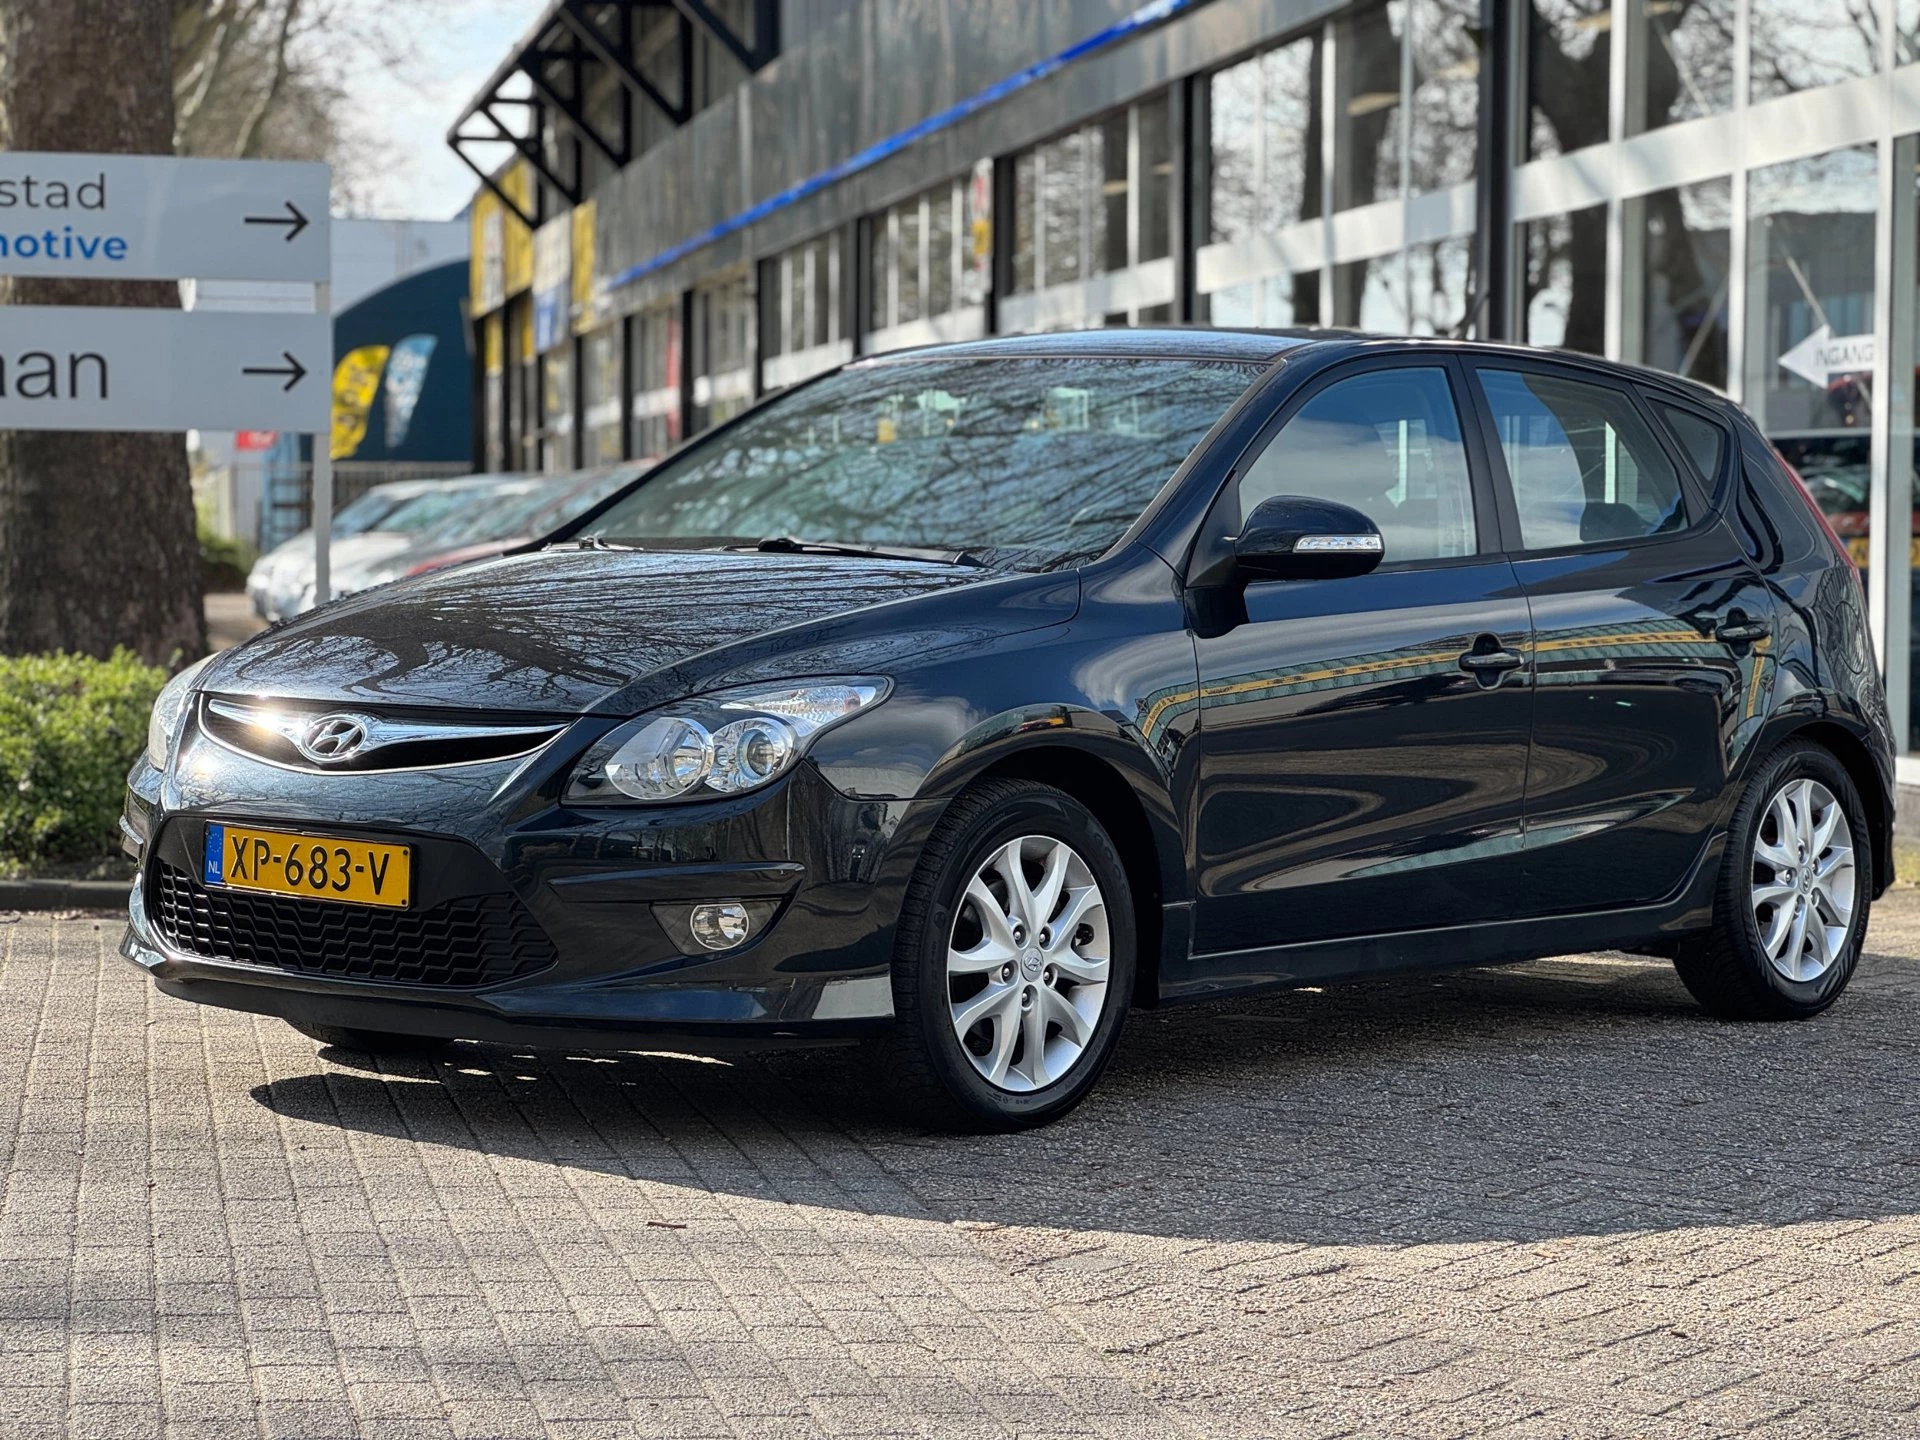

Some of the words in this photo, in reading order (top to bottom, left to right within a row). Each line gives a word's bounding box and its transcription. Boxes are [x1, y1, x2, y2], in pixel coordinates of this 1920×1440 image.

[0, 351, 108, 399] an
[208, 860, 221, 875] NL
[230, 834, 390, 896] XP-683-V
